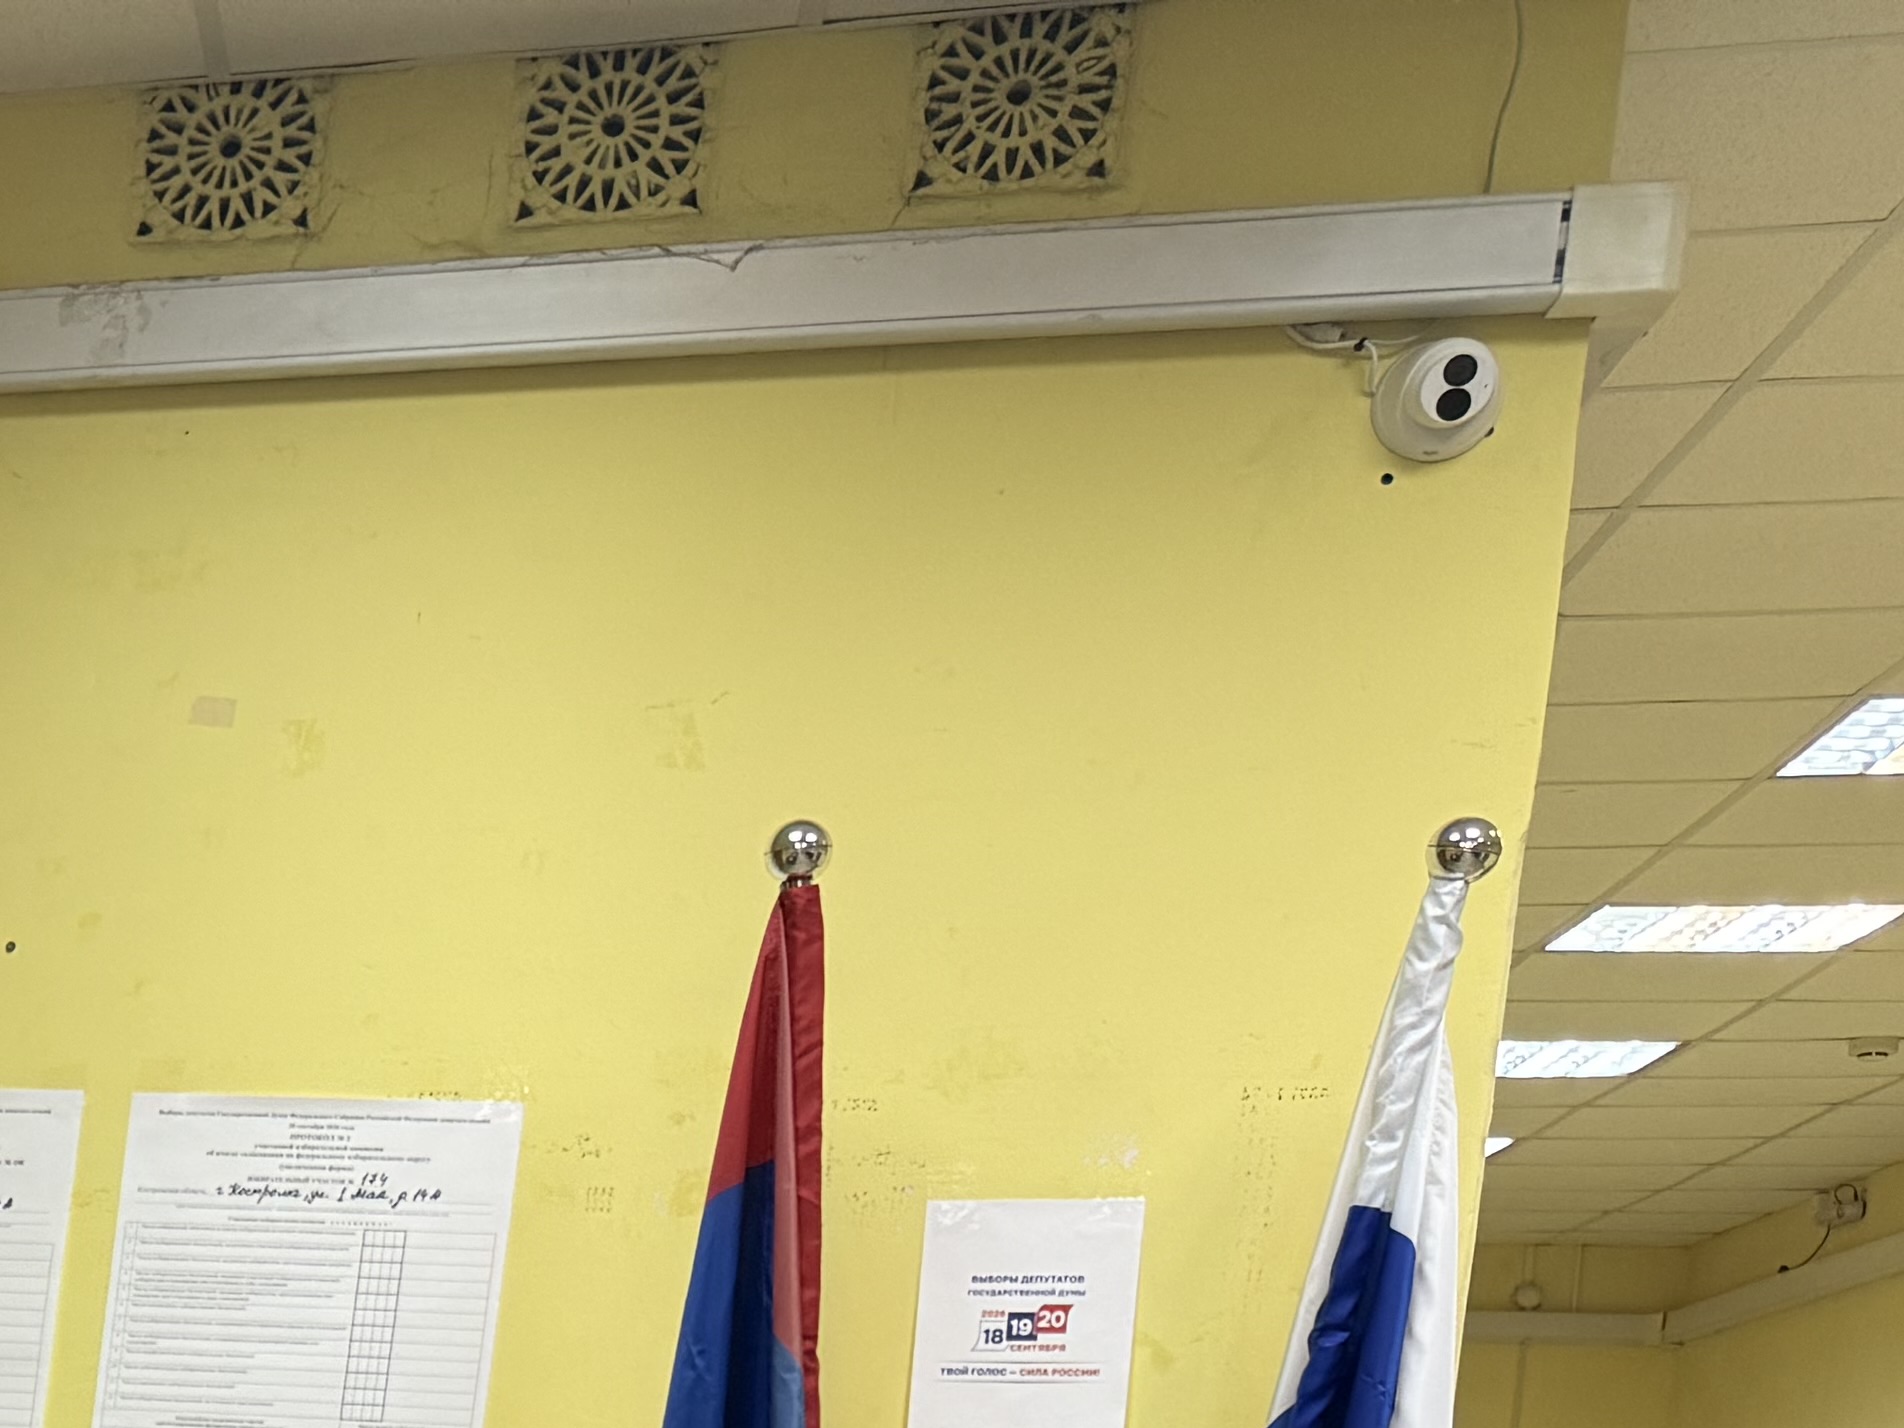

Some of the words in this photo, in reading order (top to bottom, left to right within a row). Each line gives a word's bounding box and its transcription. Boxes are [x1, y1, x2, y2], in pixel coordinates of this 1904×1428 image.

[971, 1275, 1019, 1284] ВЫБОРЫ
[1021, 1275, 1086, 1284] ДЕПУТАТОВ
[967, 1288, 1056, 1297] ГОСУДАРСТВЕННОЙ
[1057, 1289, 1087, 1297] ДУМЫ
[983, 1328, 1004, 1344] 18
[1010, 1318, 1033, 1336] 19
[1037, 1310, 1066, 1328] 20
[1009, 1344, 1066, 1352] СЕНТЯБРЯ
[940, 1365, 969, 1376] ТВОЙ
[971, 1367, 1007, 1376] ГОЛОС
[1019, 1367, 1049, 1377] СИЛА
